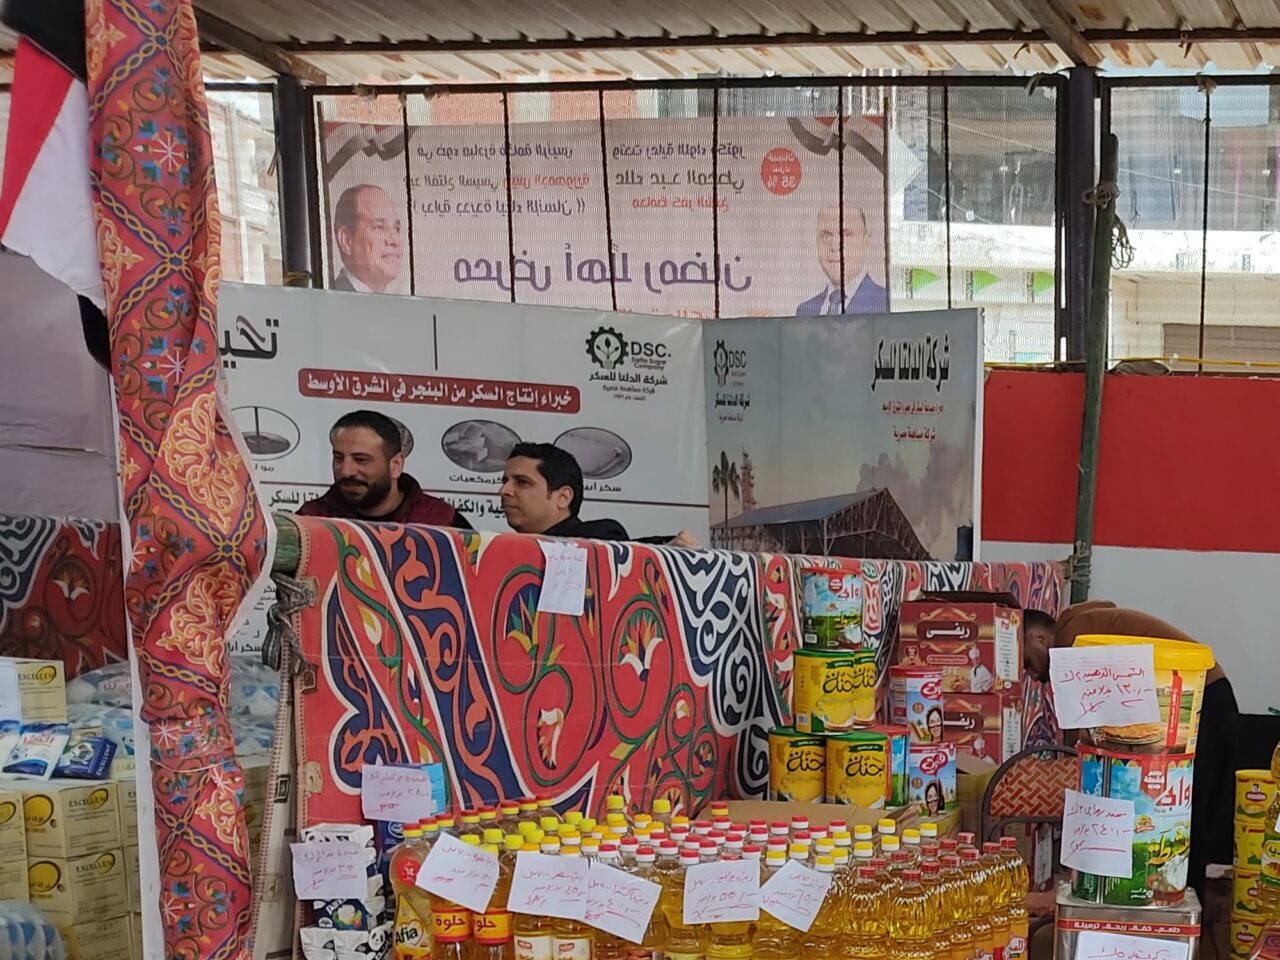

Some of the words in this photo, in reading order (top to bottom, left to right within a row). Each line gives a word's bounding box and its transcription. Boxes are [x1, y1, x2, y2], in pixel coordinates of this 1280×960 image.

[219, 314, 280, 369] تحي
[926, 333, 950, 392] شركة
[352, 376, 390, 397] الشرق
[589, 371, 616, 381] للسكر
[618, 372, 640, 383] الدلتا
[643, 375, 668, 386] شركة
[391, 378, 408, 402] في
[409, 380, 449, 402] البنجر
[451, 383, 466, 402] من
[468, 383, 504, 404] السكر
[505, 386, 538, 409] إنتاج
[540, 386, 573, 411] خبراء
[942, 712, 976, 730] ريف
[435, 915, 465, 930] حلوة
[474, 916, 497, 931] حلو
